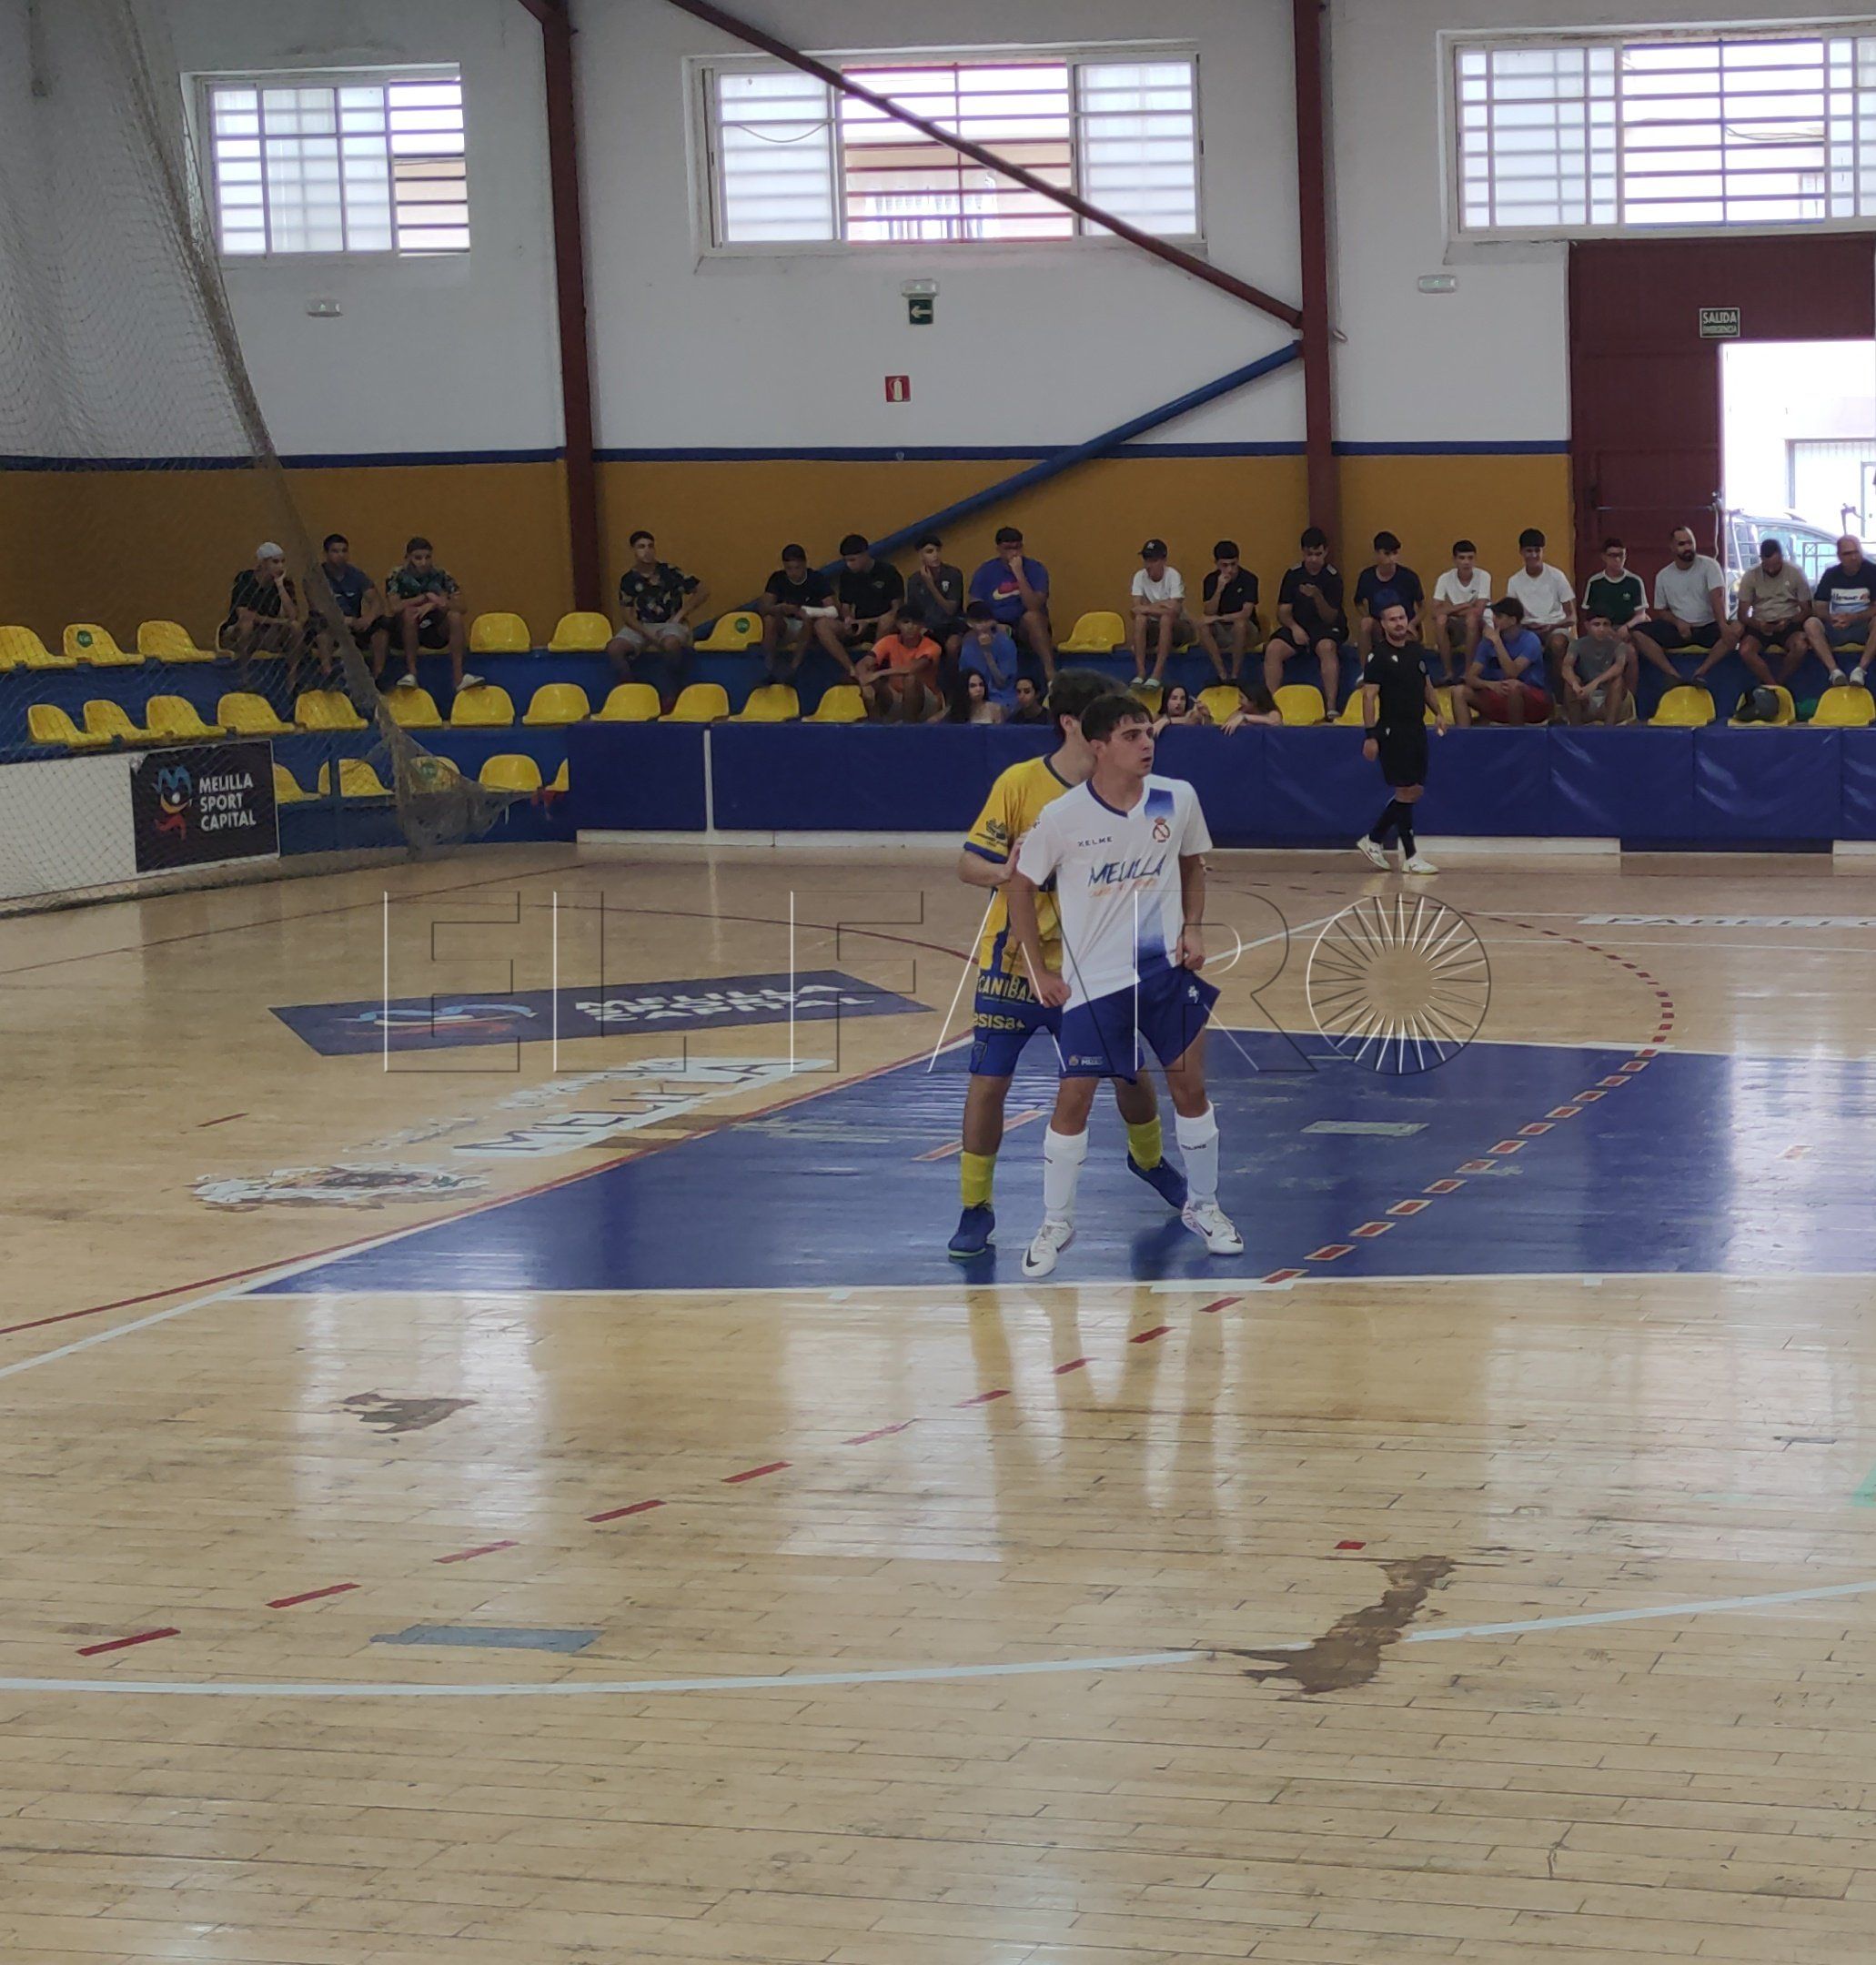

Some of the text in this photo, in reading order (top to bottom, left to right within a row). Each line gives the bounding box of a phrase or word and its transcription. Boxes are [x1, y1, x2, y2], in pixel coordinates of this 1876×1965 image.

[1702, 311, 1737, 324] SALIDA
[199, 772, 254, 794] MELILLA
[200, 791, 244, 812] SPORT
[201, 809, 257, 831] CAPITAL
[1087, 853, 1167, 888] MELILLA
[594, 997, 876, 1022] CAPITAL
